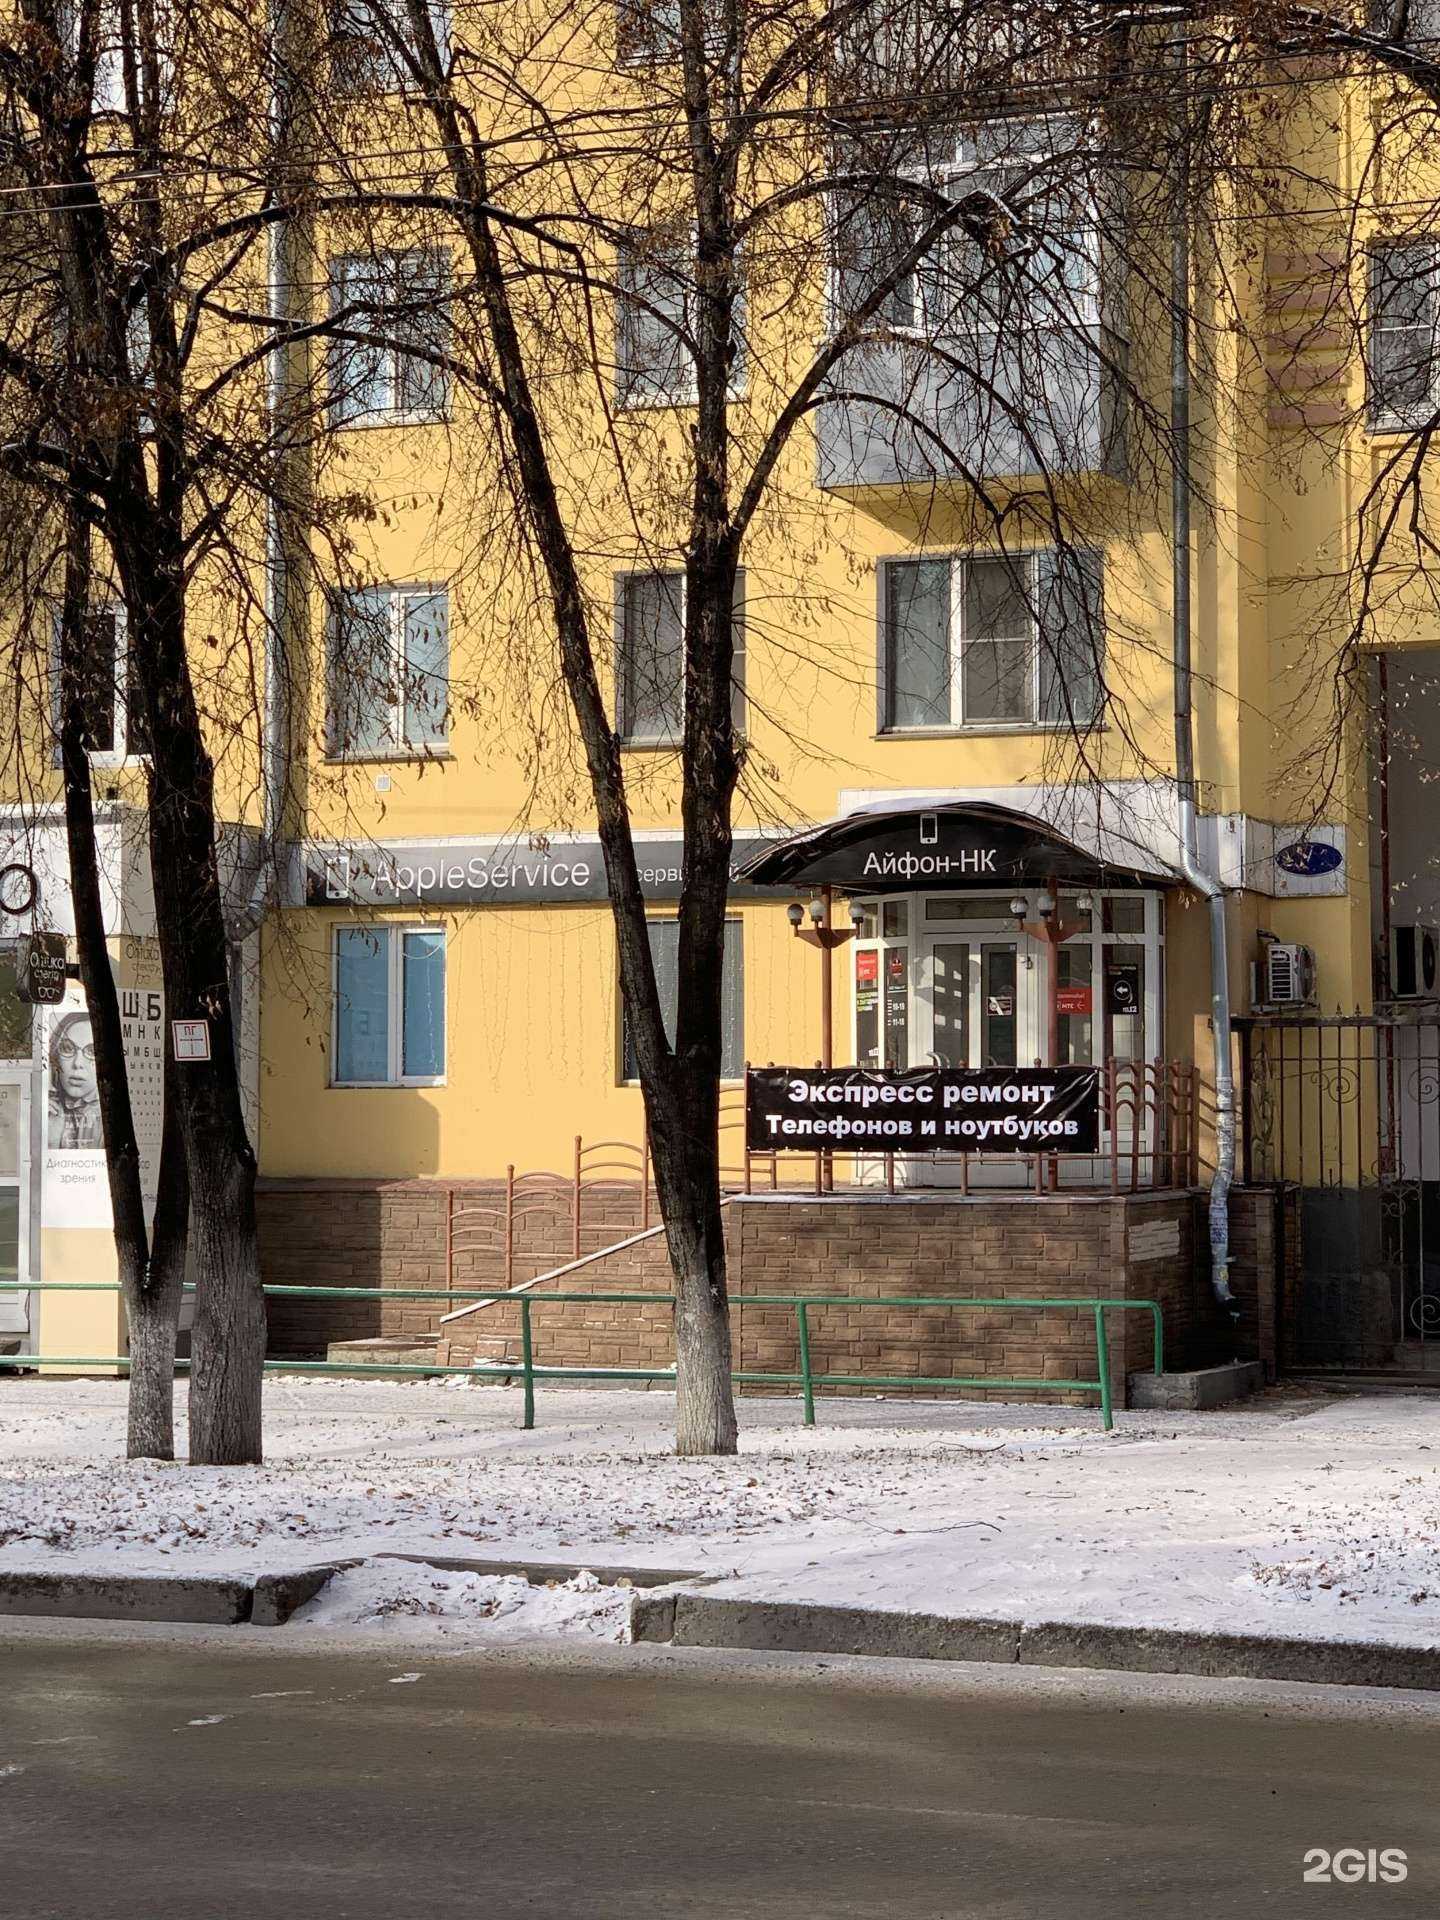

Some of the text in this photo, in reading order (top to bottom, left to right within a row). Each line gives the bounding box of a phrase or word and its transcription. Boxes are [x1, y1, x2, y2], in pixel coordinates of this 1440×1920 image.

[370, 857, 591, 898] AppleService
[863, 849, 997, 879] Айфон-НК
[788, 1079, 1055, 1108] Экспресс ремонт
[765, 1114, 1079, 1140] Телефонов и ноутбуков
